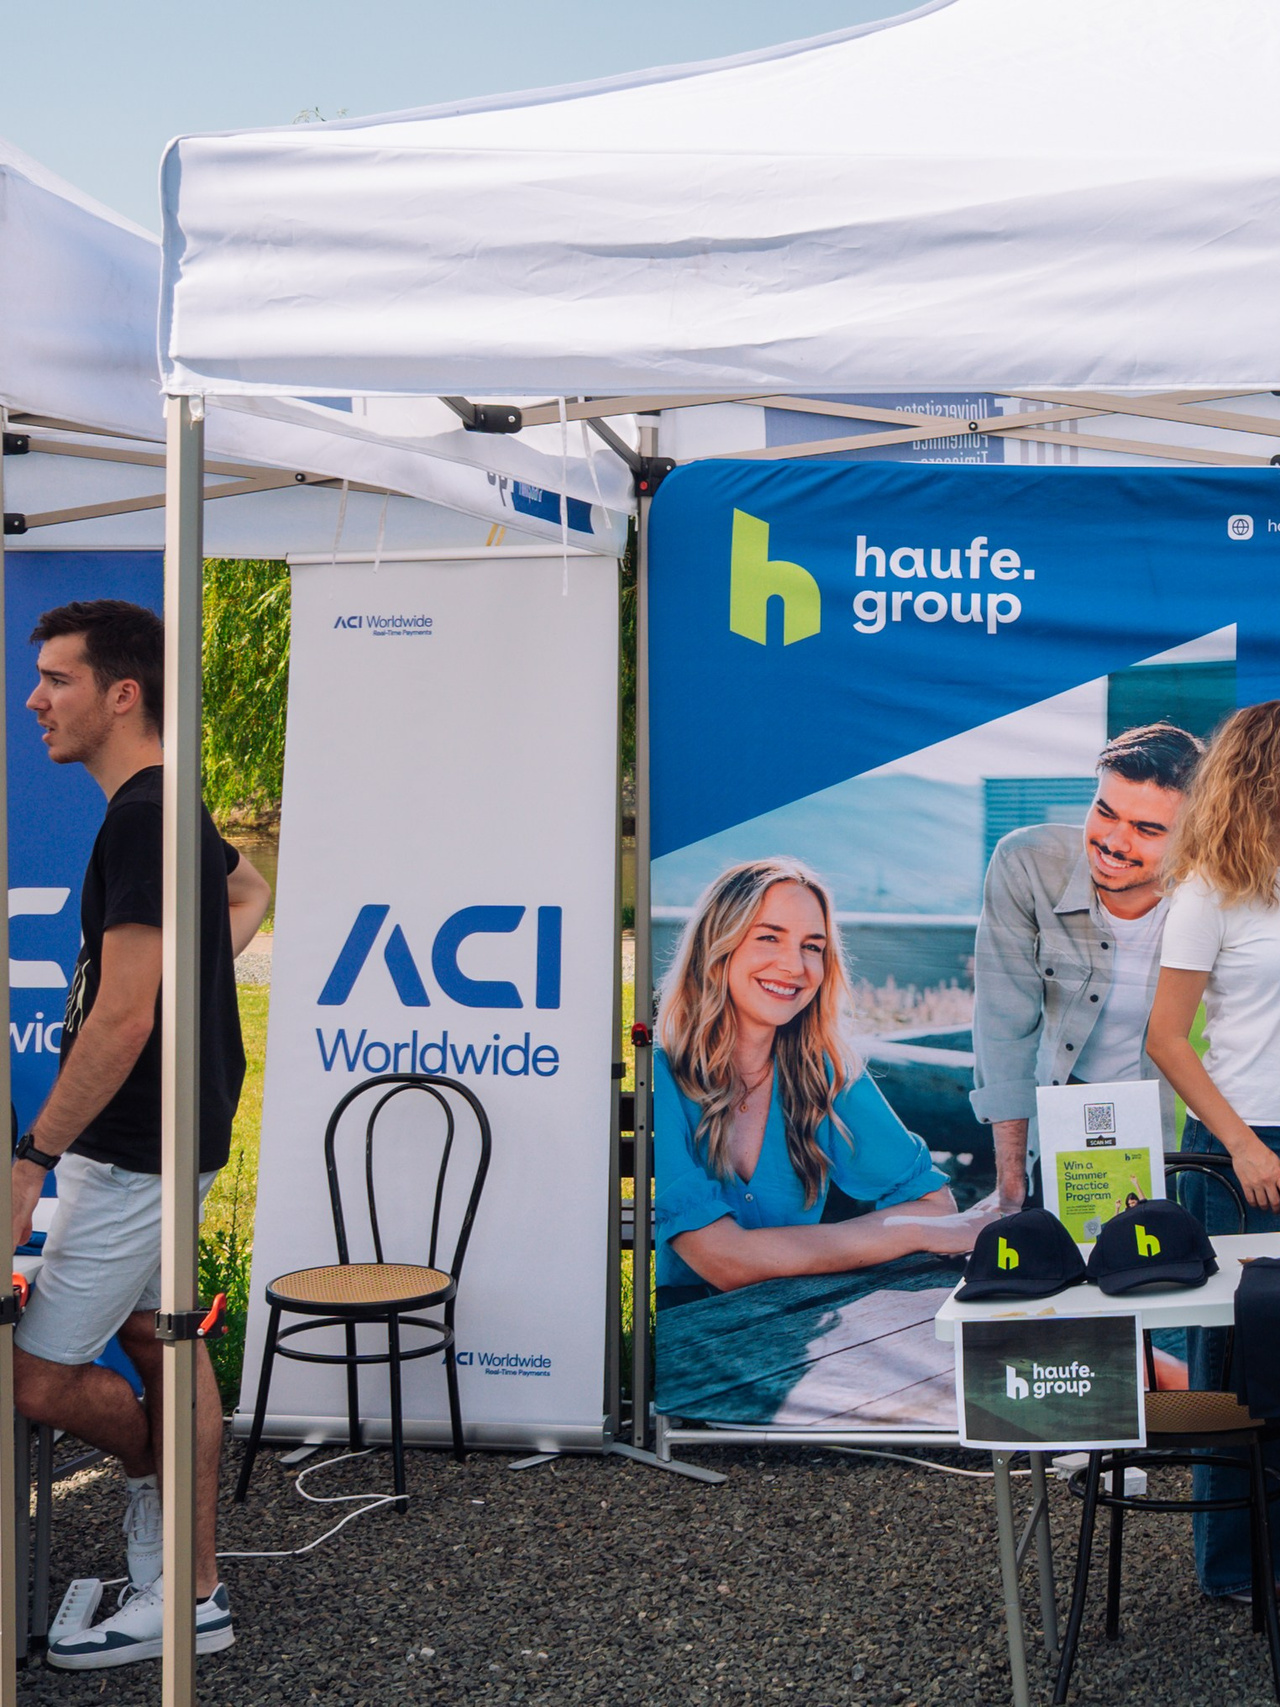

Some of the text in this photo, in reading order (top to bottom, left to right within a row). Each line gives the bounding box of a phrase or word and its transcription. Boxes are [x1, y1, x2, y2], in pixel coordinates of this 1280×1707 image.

[855, 535, 1036, 581] haufe.
[852, 590, 1022, 635] group
[333, 614, 433, 629] ACI Worldwide
[372, 629, 432, 637] Real-Time Payments
[316, 904, 563, 1010] ACI
[315, 1028, 560, 1077] Worldwide
[1064, 1160, 1094, 1171] Win a
[1065, 1172, 1108, 1182] Summer
[1065, 1181, 1110, 1192] Practice
[1065, 1192, 1112, 1204] Program
[477, 1352, 552, 1368] Worldwide
[485, 1368, 551, 1377] Real-Time Payments
[1032, 1361, 1096, 1380] haufe.
[1033, 1378, 1092, 1399] group
